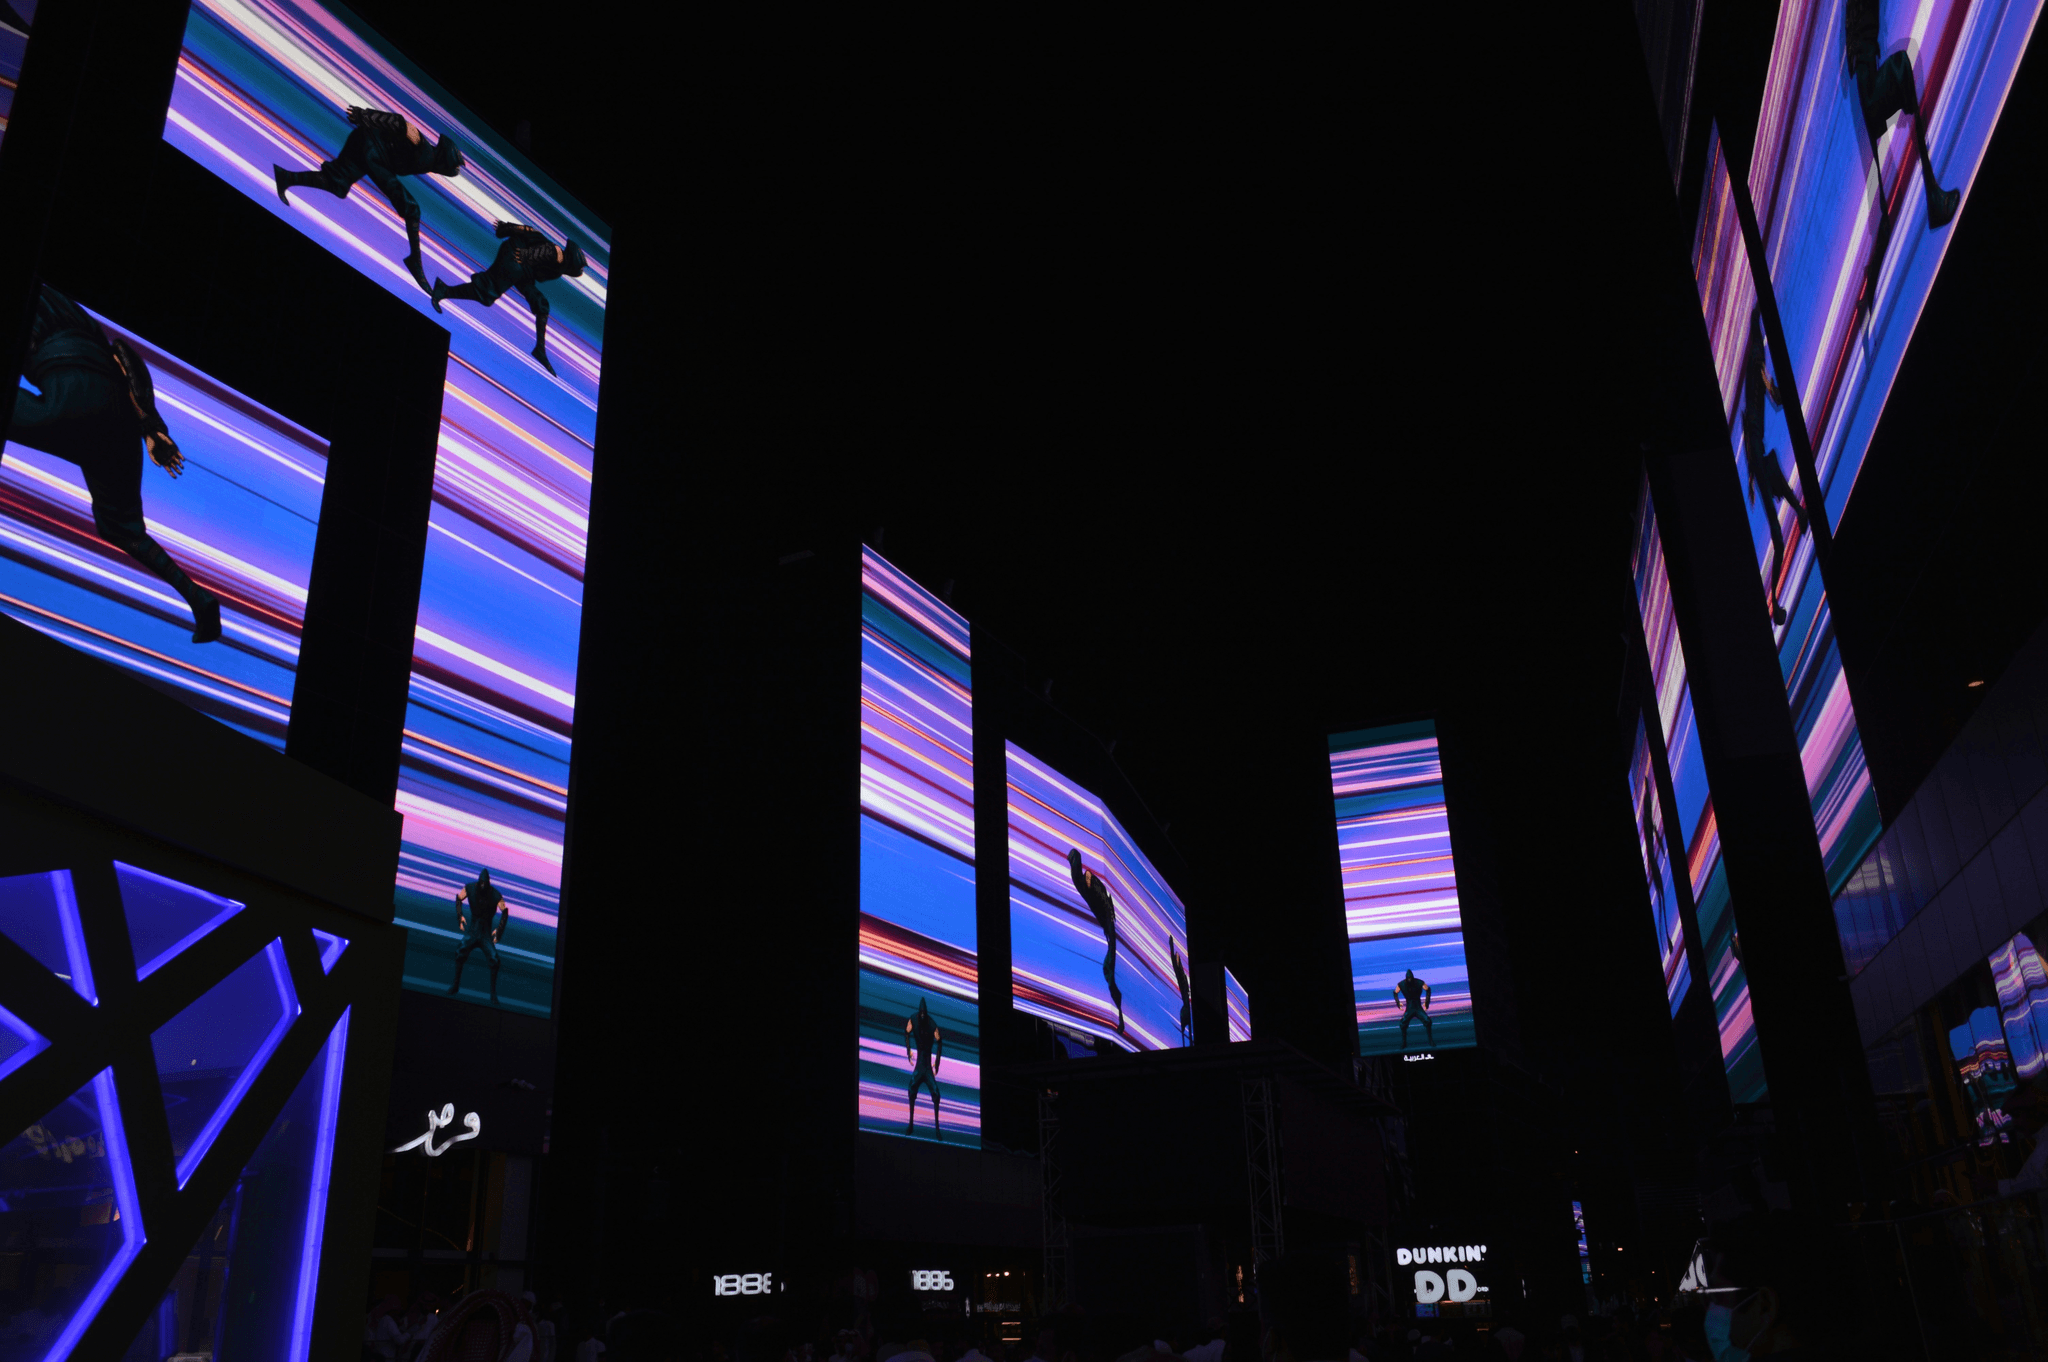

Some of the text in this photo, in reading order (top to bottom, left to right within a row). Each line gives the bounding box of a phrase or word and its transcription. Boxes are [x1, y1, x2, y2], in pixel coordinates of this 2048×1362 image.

[1396, 1244, 1487, 1266] DUNKIN'
[911, 1269, 955, 1291] 1886
[1414, 1268, 1478, 1304] DD
